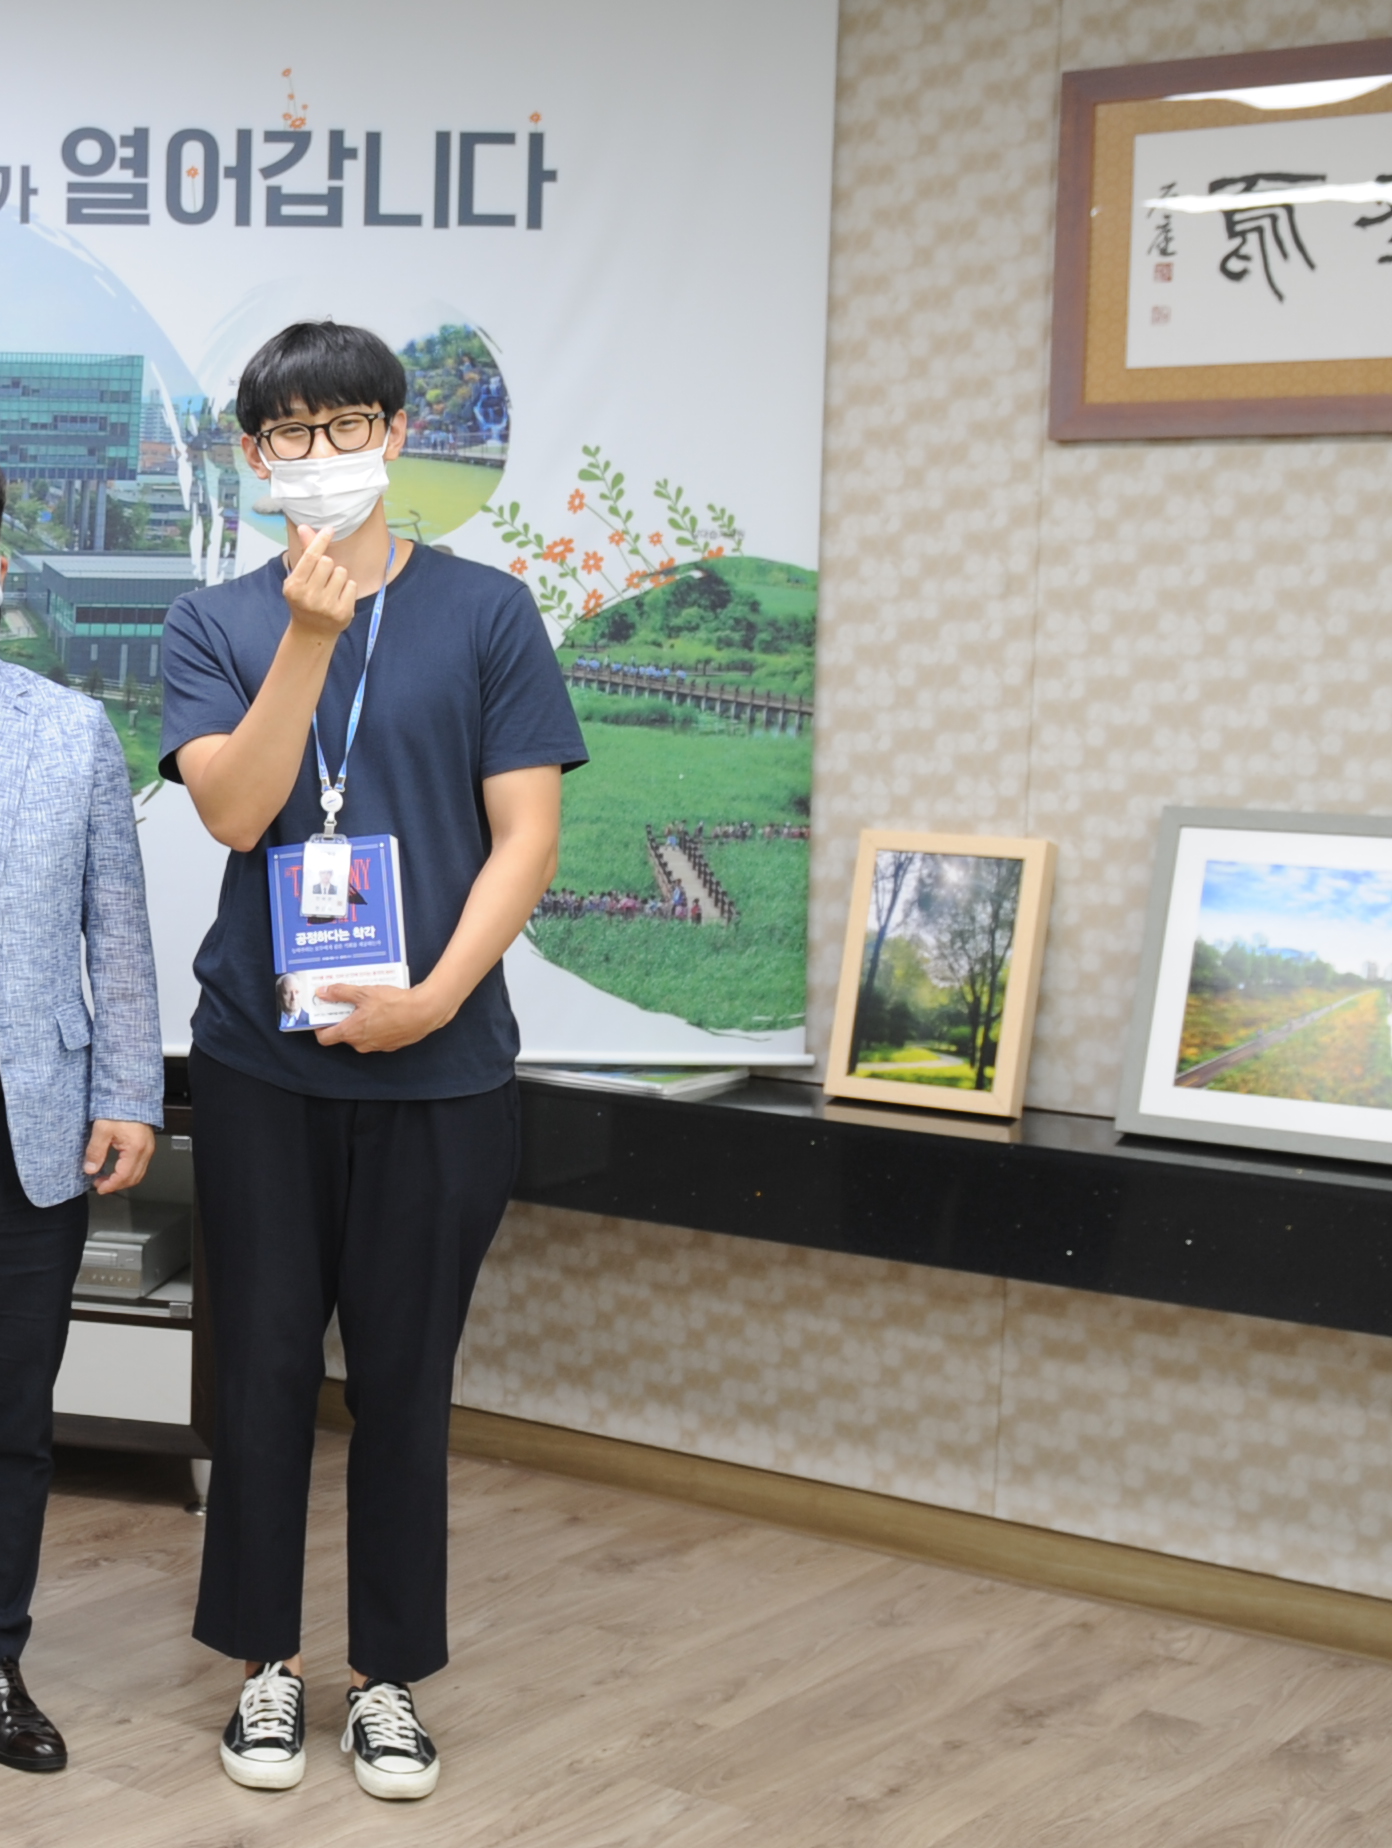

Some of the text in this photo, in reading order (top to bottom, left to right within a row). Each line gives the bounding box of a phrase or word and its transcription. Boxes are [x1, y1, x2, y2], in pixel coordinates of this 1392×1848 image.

[60, 127, 557, 230] 열어갑니다
[295, 925, 376, 946] 공정하다는 착각
